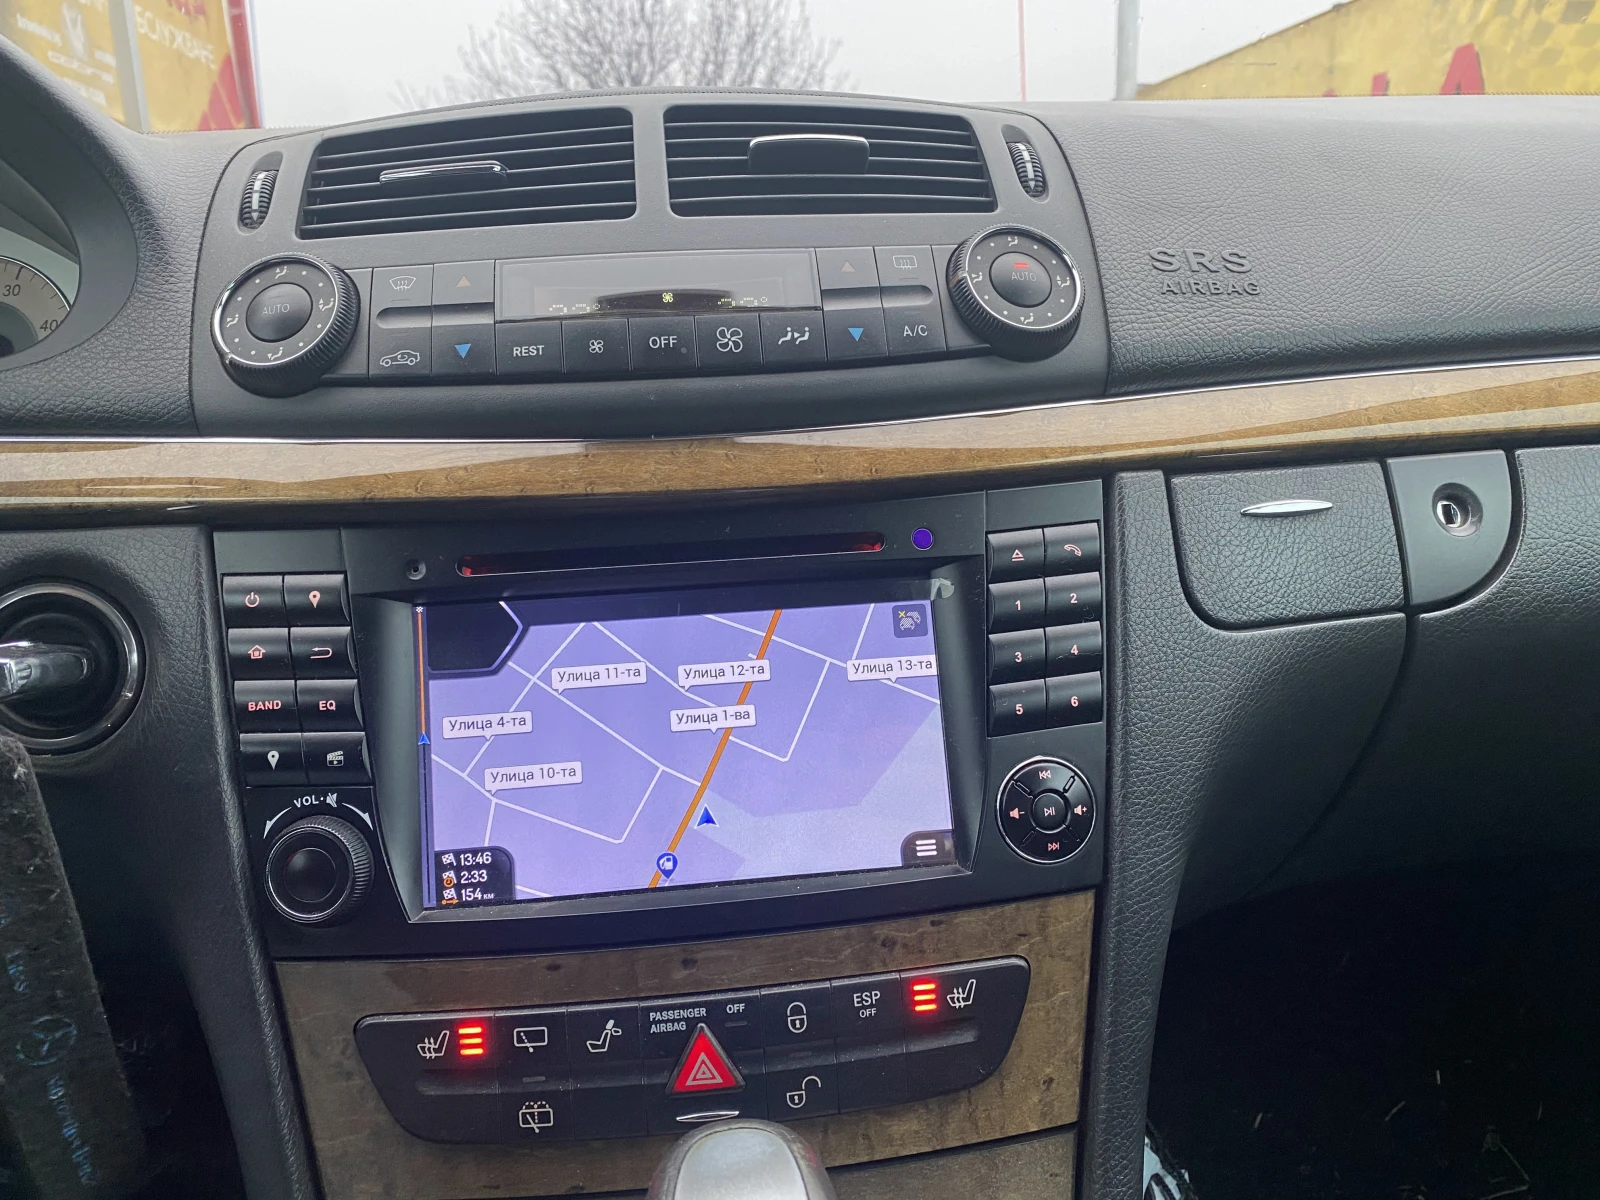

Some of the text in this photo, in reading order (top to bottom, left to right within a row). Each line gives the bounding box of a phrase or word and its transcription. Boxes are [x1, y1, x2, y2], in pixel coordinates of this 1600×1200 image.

[1149, 248, 1252, 273] SRS
[1010, 271, 1037, 283] AUTO
[2, 284, 21, 297] 30
[1161, 280, 1260, 296] AIRBAG
[262, 302, 290, 316] AUTO
[40, 319, 59, 332] 40
[903, 323, 928, 338] A/C
[649, 335, 678, 350] OFF
[513, 344, 544, 358] REST
[1015, 600, 1022, 611] 1
[1070, 593, 1078, 604] 2
[1070, 644, 1079, 655] 4
[1015, 652, 1022, 663] 3
[557, 665, 642, 684] Улица 11-та
[684, 663, 765, 682] Улица 12-та
[852, 658, 933, 677] Улица 13-та
[248, 700, 282, 711] BAND
[319, 700, 337, 711] EQ
[1071, 696, 1079, 707] 6
[1016, 704, 1023, 715] 5
[448, 715, 527, 733] Улица 4-та
[676, 709, 751, 726] Улица 1-ва
[490, 766, 577, 785] Улица 10-та
[293, 794, 319, 808] VOL
[460, 852, 492, 866] 13:46
[460, 869, 487, 884] 2:33
[461, 888, 482, 901] 154
[853, 990, 881, 1007] ESP
[649, 1007, 707, 1022] PASSENGER
[726, 1003, 746, 1014] OFF
[859, 1008, 877, 1018] OFF
[650, 1021, 687, 1034] AIRBAG
